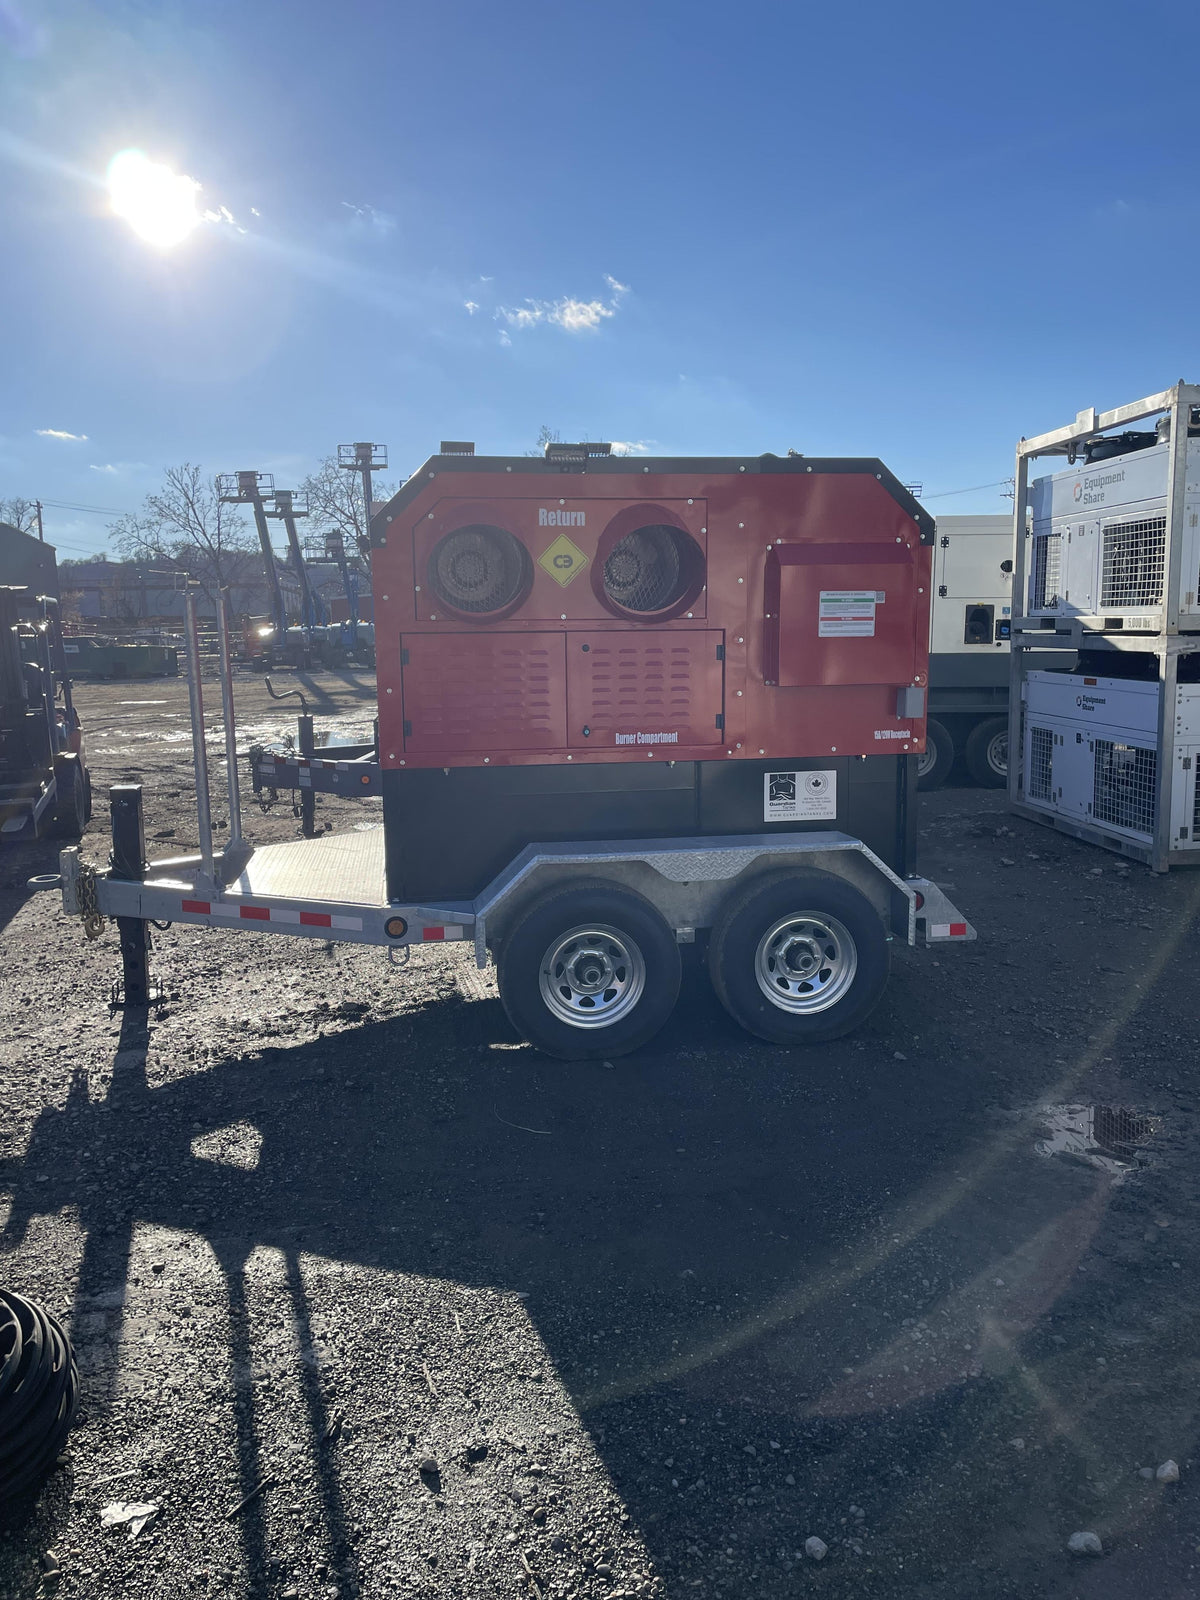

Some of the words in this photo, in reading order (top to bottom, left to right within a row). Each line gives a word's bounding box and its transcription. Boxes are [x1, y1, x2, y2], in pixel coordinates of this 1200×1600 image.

[1084, 470, 1125, 491] Equipment
[1083, 492, 1105, 505] Share
[538, 508, 585, 526] Return
[1082, 695, 1106, 704] Equipment
[615, 732, 636, 744] Burner
[637, 731, 678, 744] Compartment
